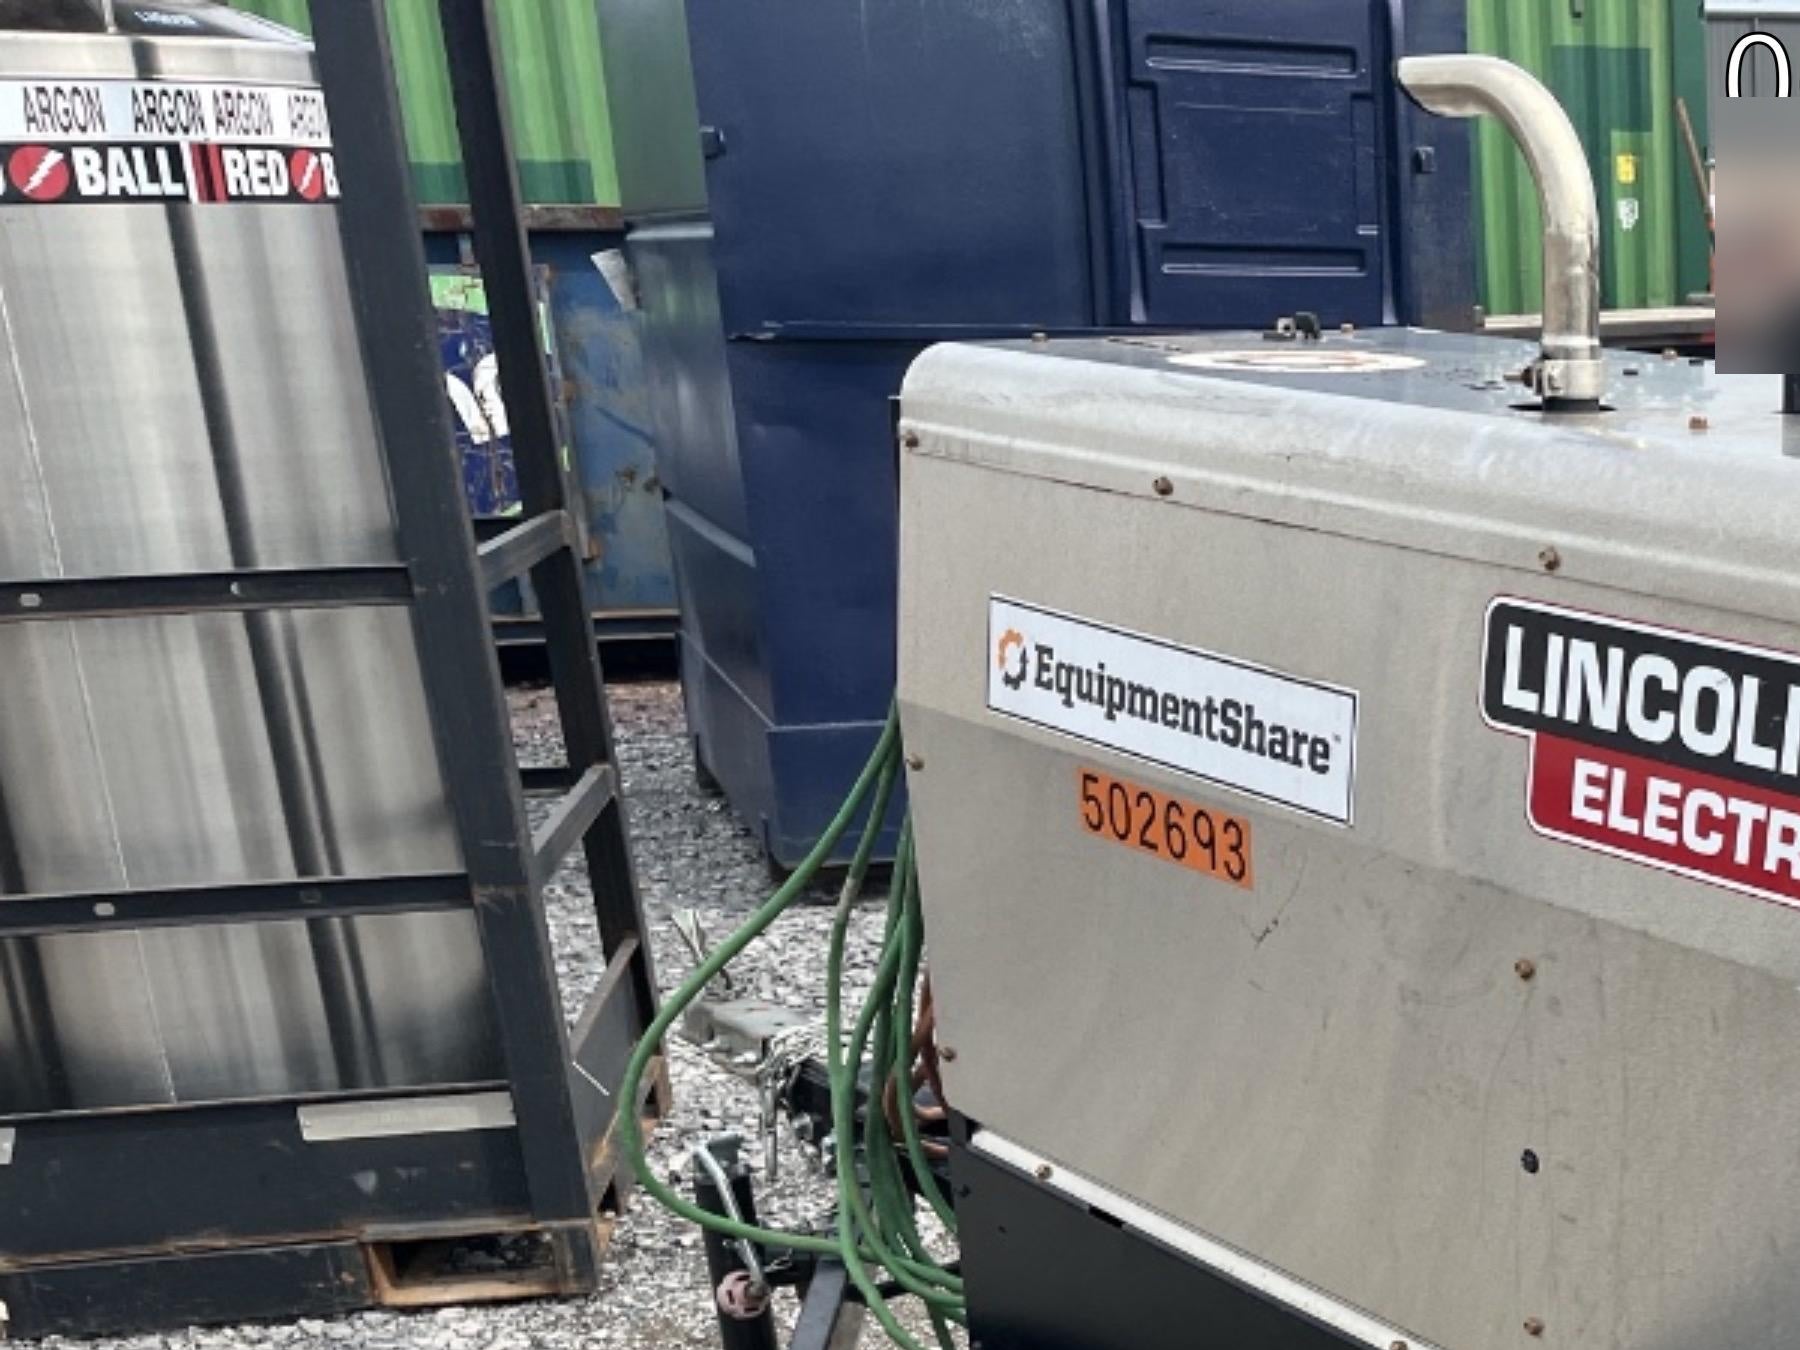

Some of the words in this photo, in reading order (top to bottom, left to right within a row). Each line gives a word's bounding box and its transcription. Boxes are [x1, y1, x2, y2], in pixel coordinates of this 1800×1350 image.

[22, 86, 107, 134] ARGON
[131, 88, 206, 135] ARGON
[212, 89, 274, 136] ARGON
[71, 147, 185, 196] BALL
[223, 149, 289, 196] RED
[1033, 643, 1331, 774] EquipmentShare
[1081, 772, 1247, 882] 502693
